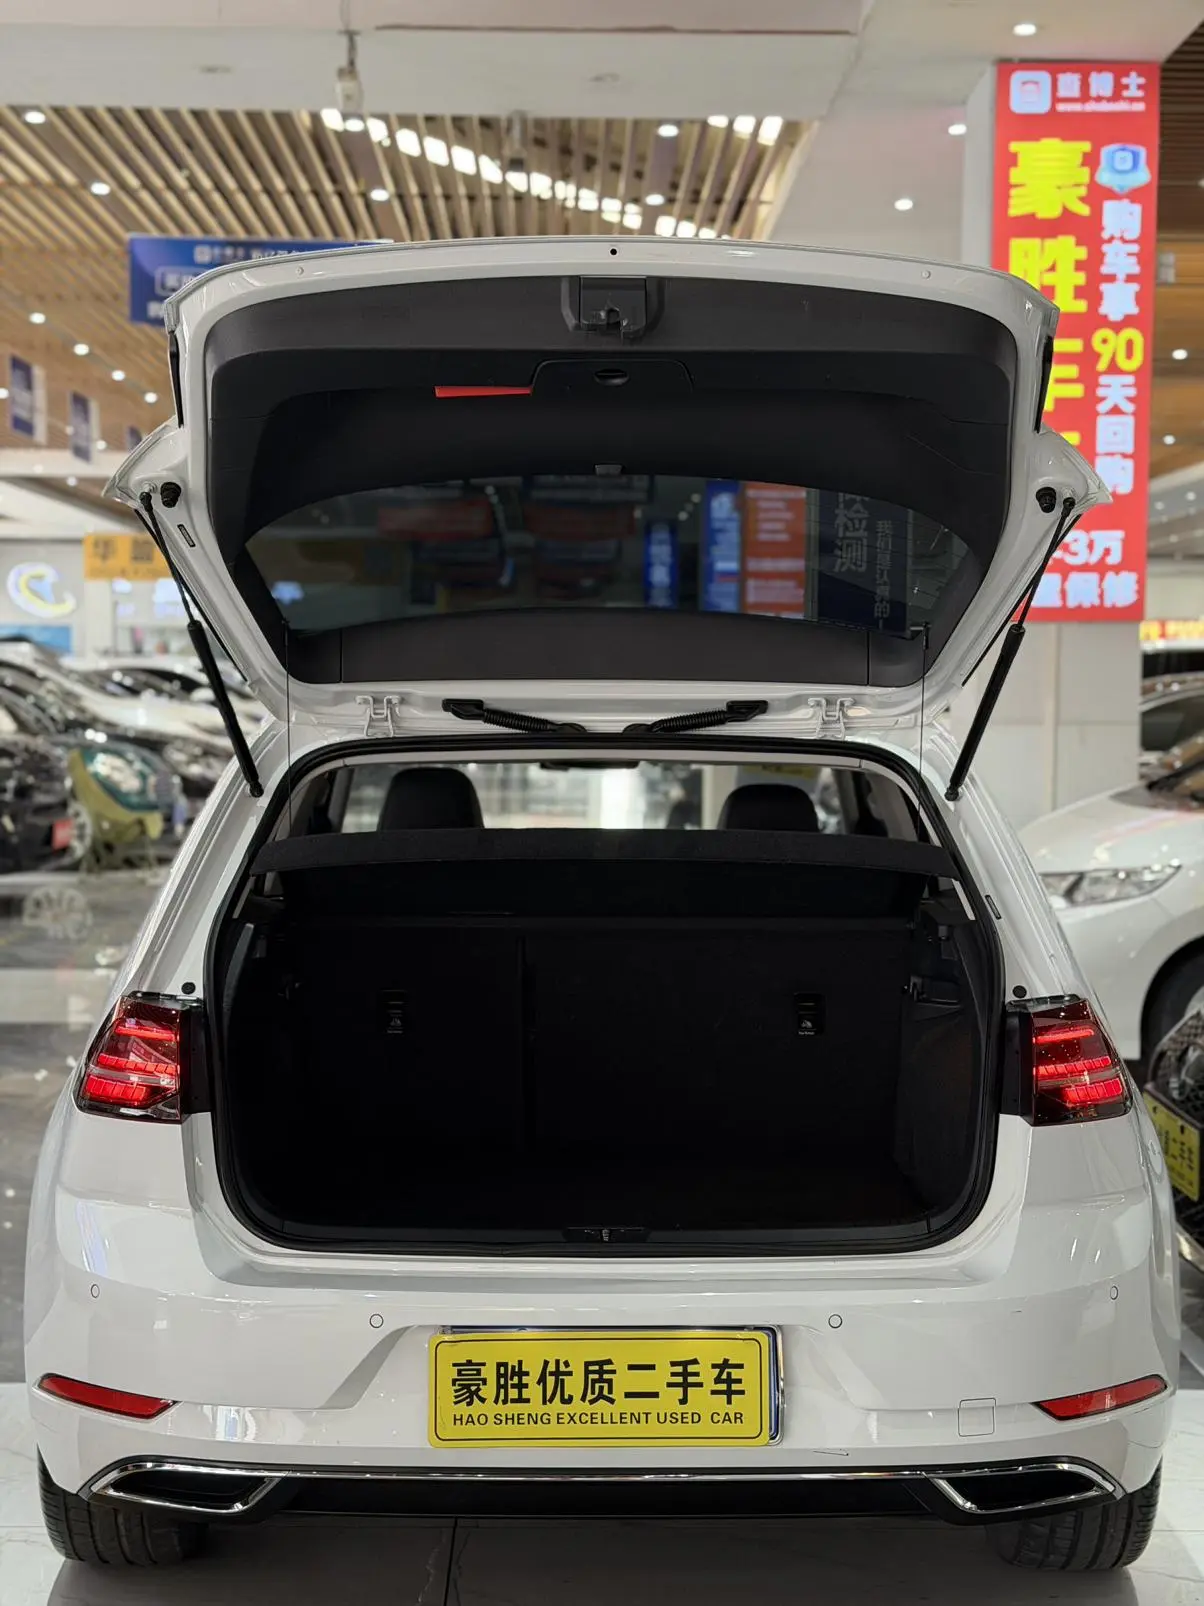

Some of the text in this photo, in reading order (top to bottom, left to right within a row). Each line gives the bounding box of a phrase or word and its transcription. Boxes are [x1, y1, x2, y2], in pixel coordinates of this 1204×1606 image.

[834, 493, 872, 573] 检测
[451, 1358, 746, 1407] 豪胜优质二手车
[453, 1412, 744, 1426] HAO SHENG EXCELLENT USED CAR
